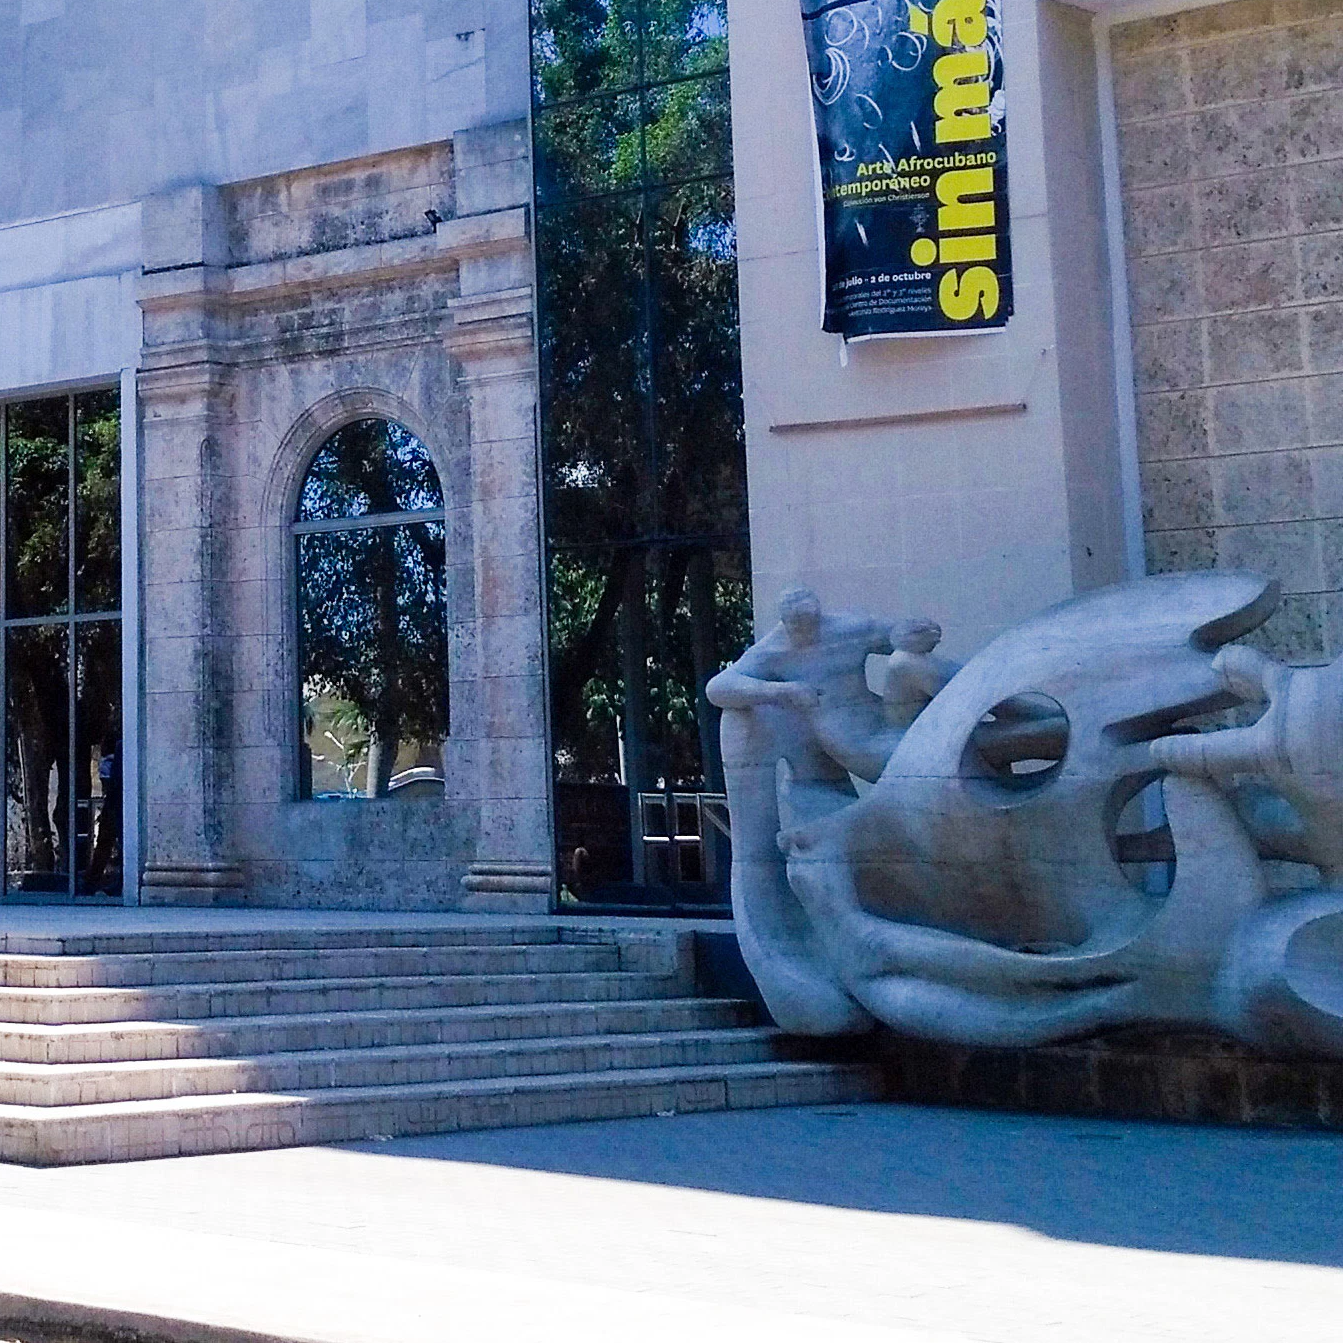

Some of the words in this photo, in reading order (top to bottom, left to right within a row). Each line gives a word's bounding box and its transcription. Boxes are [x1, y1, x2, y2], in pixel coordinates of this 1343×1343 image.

[856, 162, 893, 177] Arte
[897, 151, 997, 172] Afrocubano
[910, 166, 1000, 321] sin
[845, 275, 863, 290] julio
[870, 275, 877, 284] 2
[878, 273, 890, 283] de
[892, 271, 932, 282] octubre
